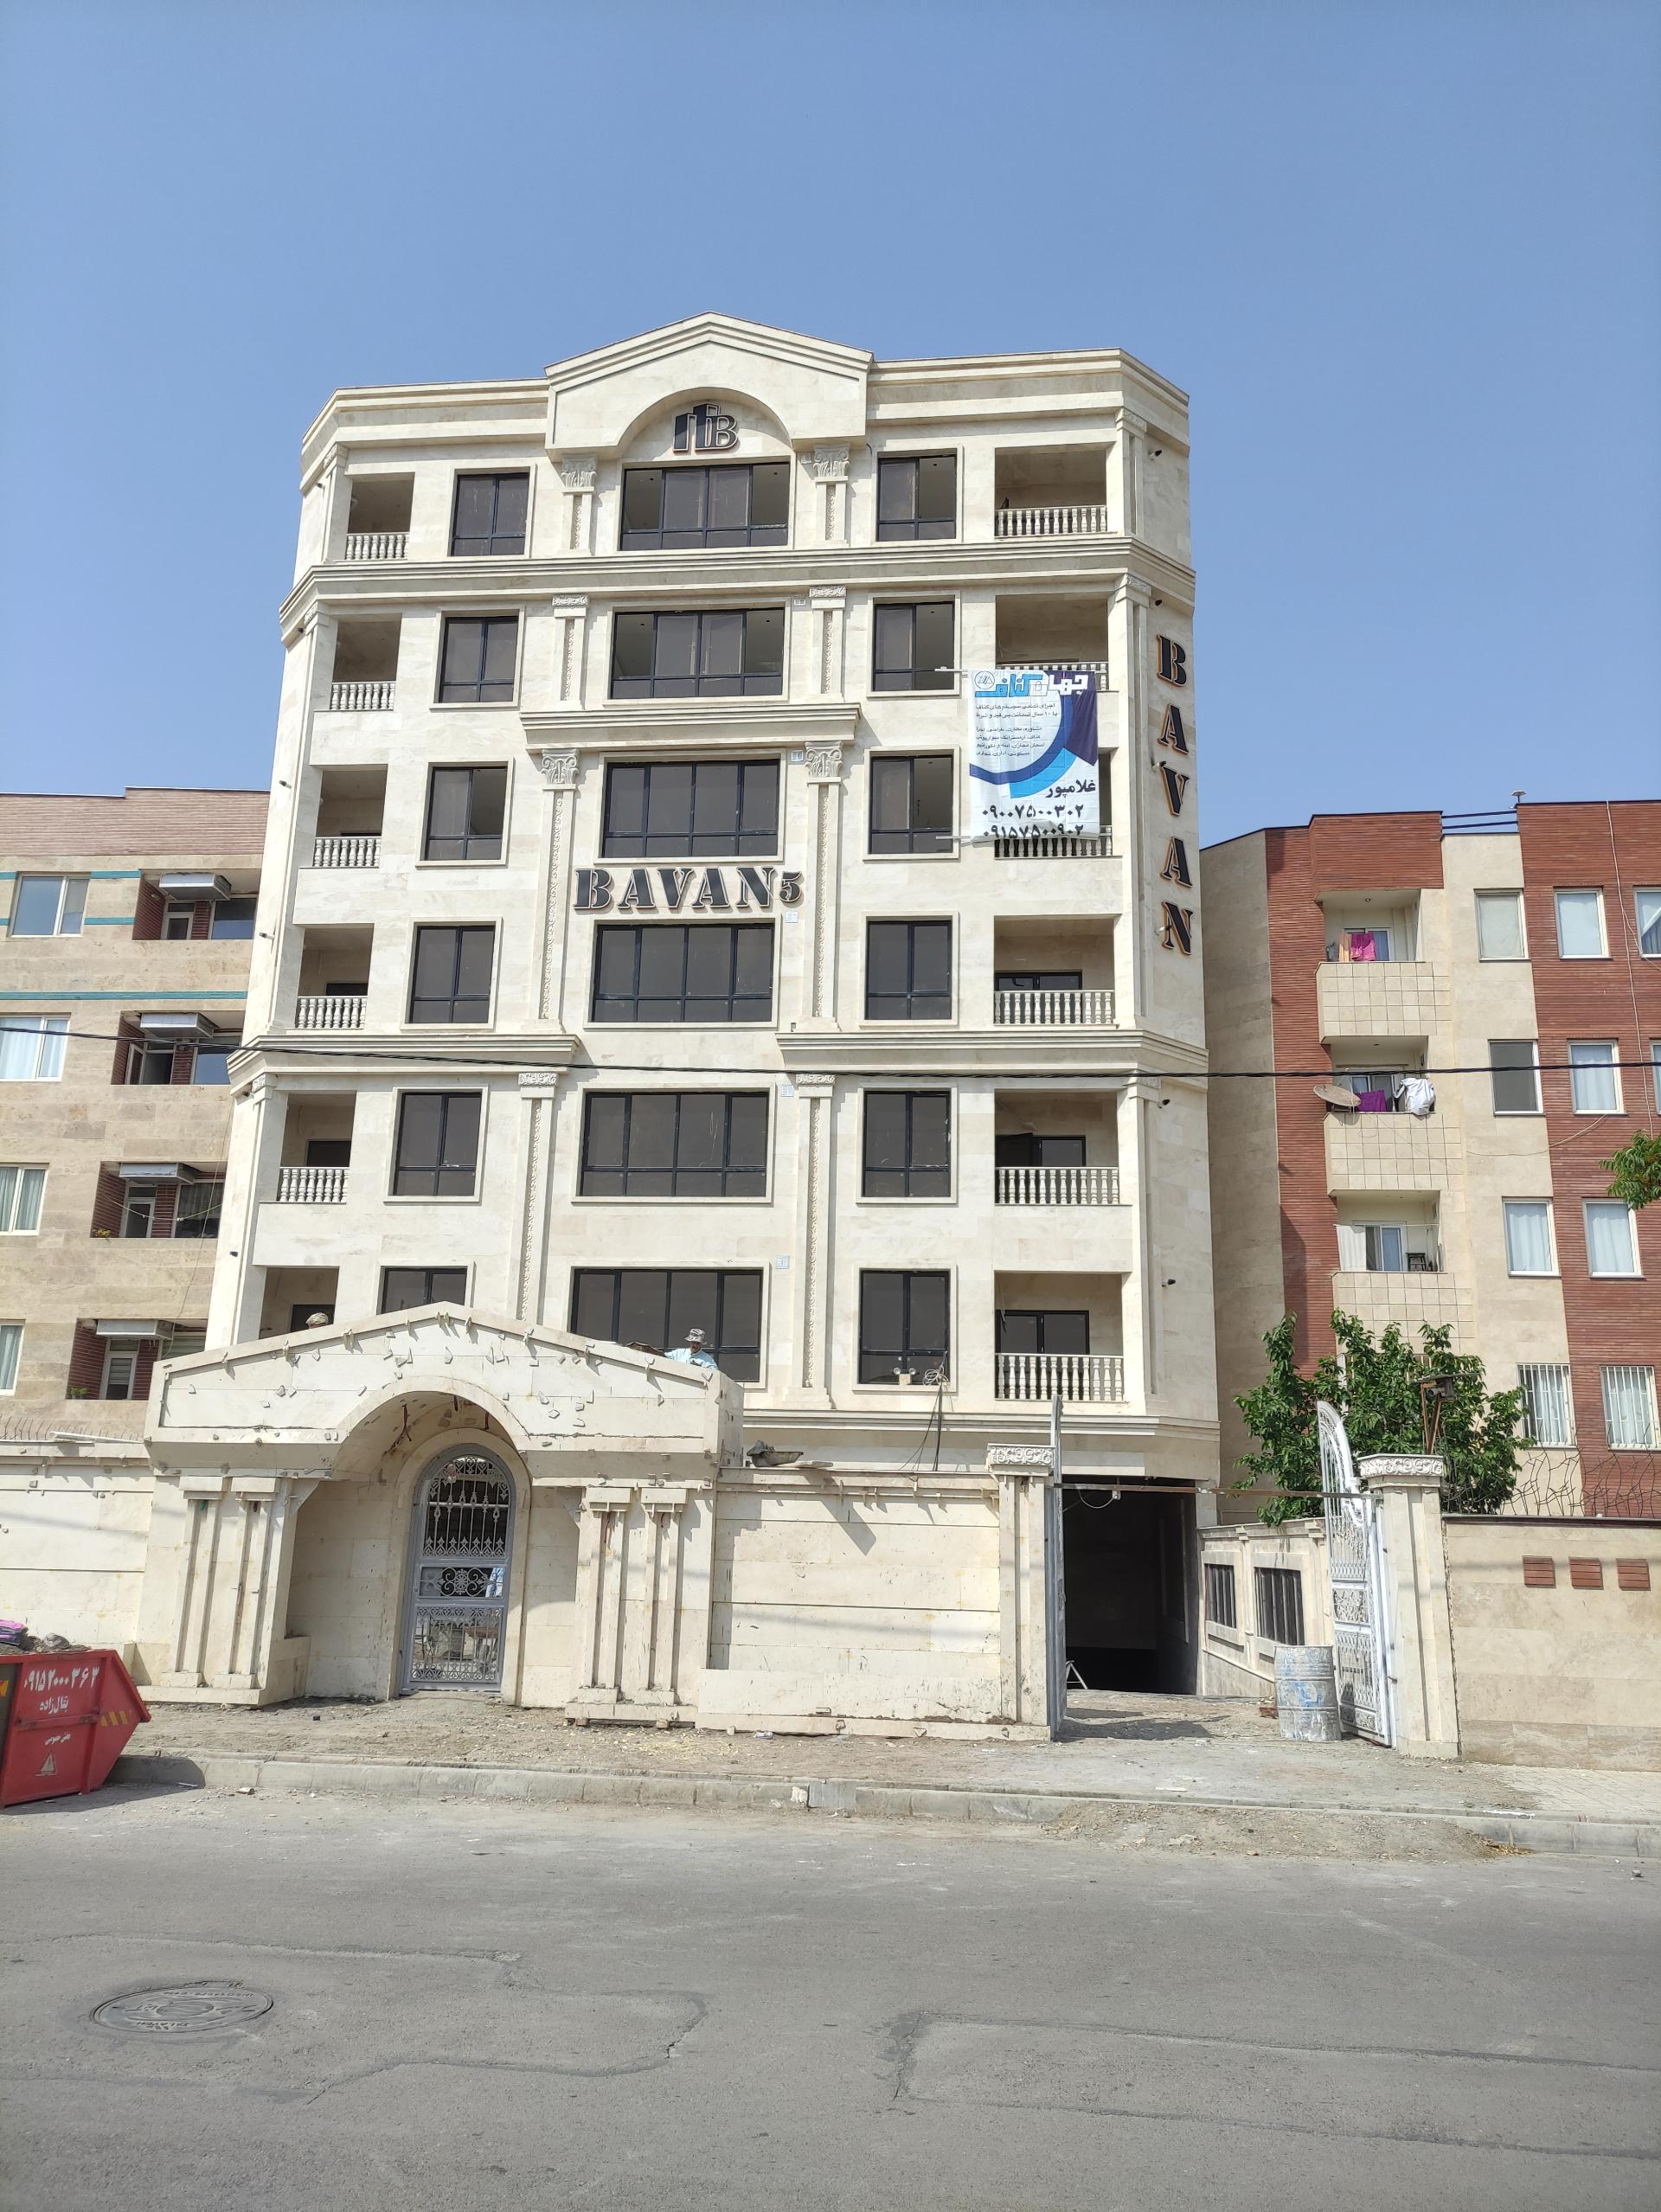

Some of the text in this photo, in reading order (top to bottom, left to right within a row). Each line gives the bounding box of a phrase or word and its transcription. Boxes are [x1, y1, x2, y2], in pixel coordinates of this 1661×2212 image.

[974, 673, 1043, 697] کناف
[1029, 674, 1088, 697] جهان
[1044, 779, 1097, 798] غلامپور
[1156, 633, 1193, 956] BAVAN
[982, 804, 1084, 819] ۰۹۰۰۷۵۰۰۳۰۲
